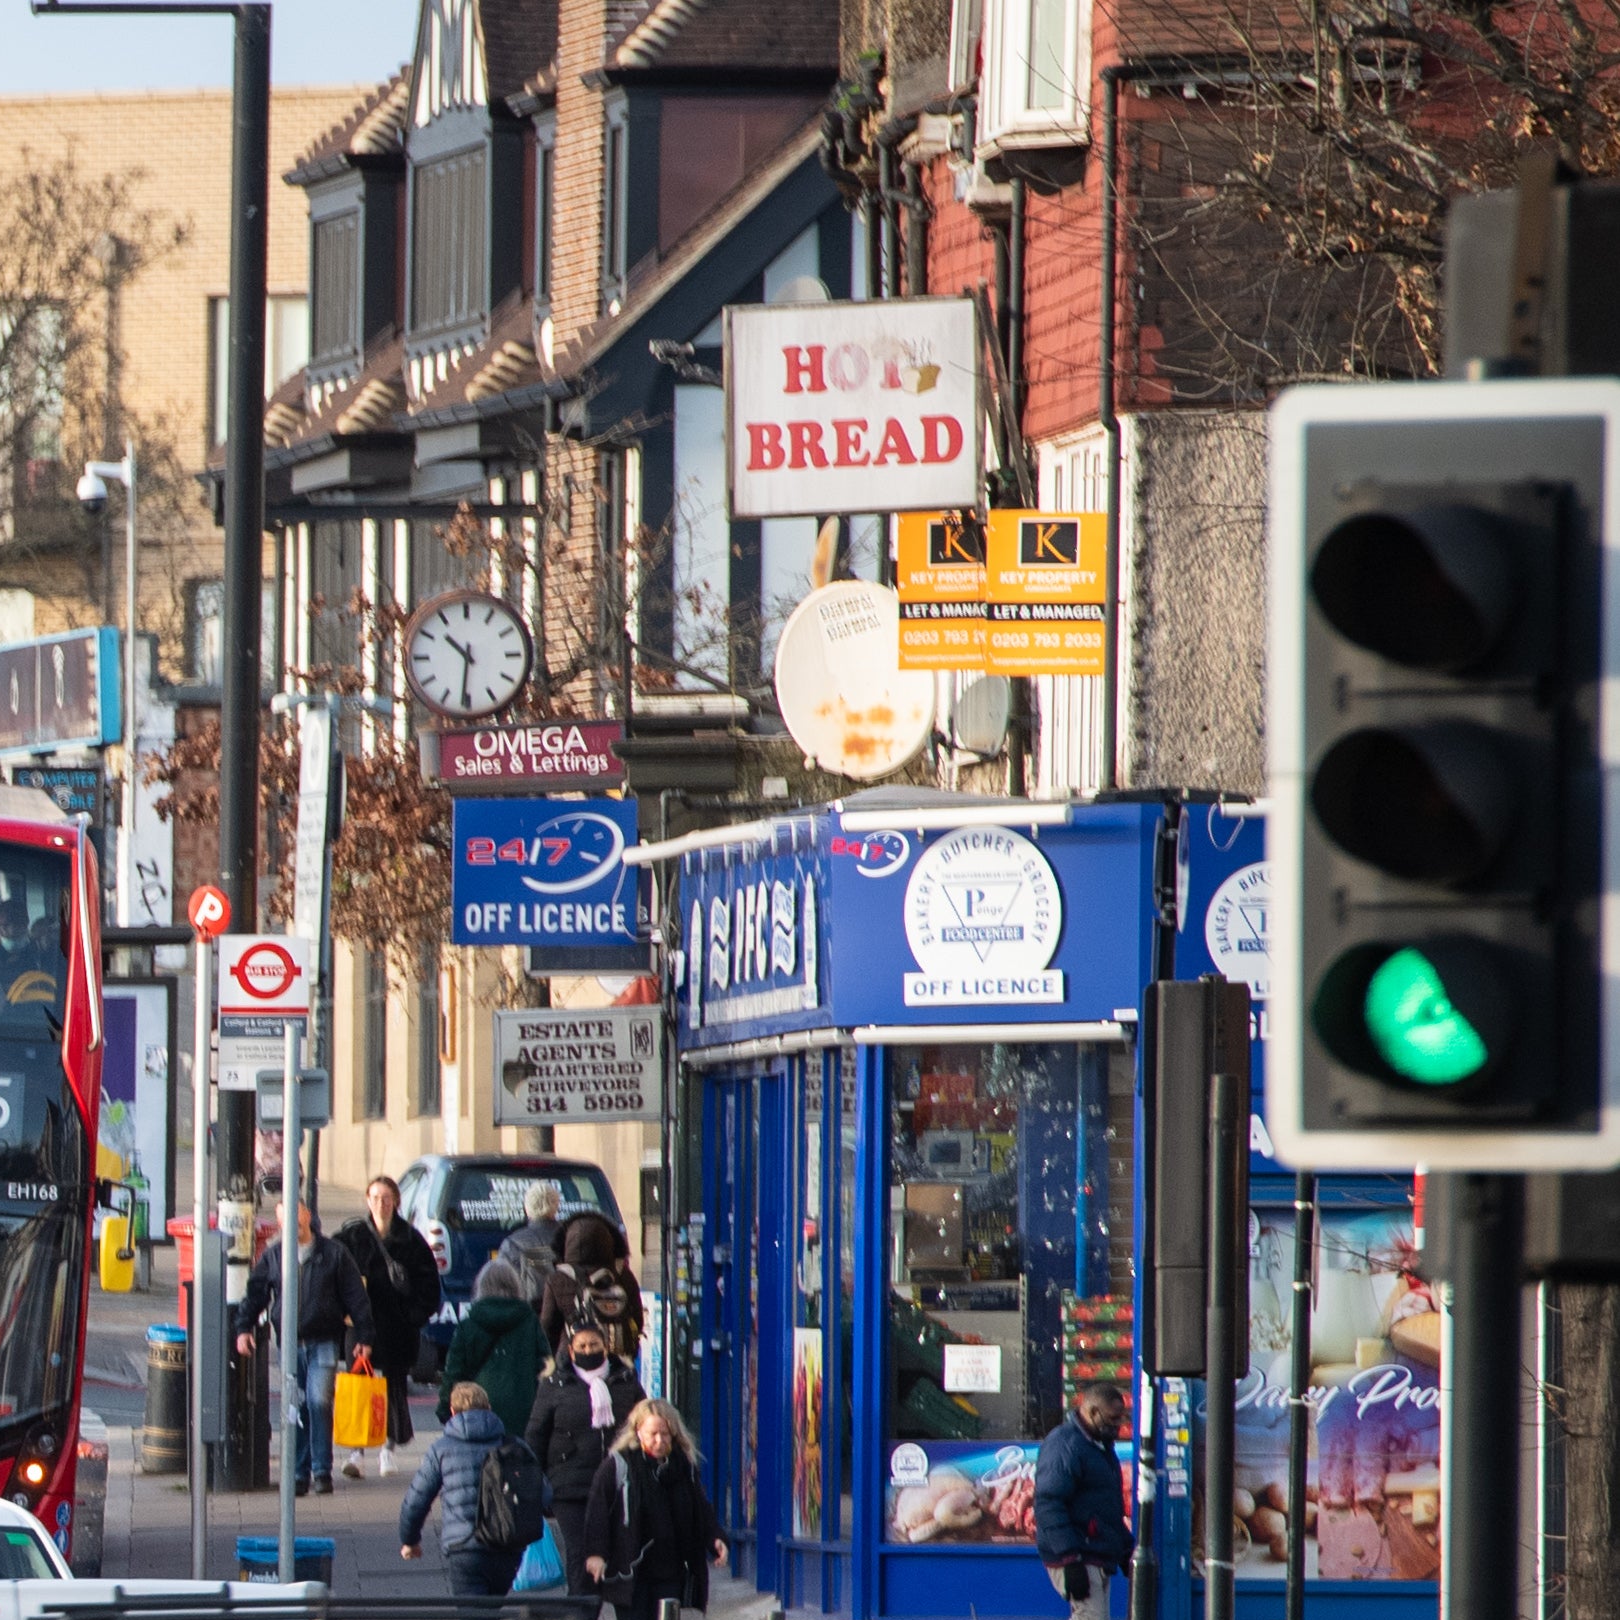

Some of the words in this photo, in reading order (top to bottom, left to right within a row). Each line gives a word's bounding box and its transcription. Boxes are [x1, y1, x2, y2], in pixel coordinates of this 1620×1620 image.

[782, 343, 903, 395] HOT
[746, 414, 964, 471] BREAD
[1035, 523, 1071, 564] K
[911, 571, 935, 583] KEY
[1000, 571, 1024, 583] KEY
[1027, 571, 1096, 585] PROPERTY
[905, 603, 928, 617] LET
[929, 604, 940, 617] &
[994, 604, 1017, 619] LET
[1018, 606, 1030, 619] &
[1032, 605, 1101, 620] MANAGED
[904, 631, 939, 645] 0203
[944, 631, 968, 643] 793
[992, 633, 1028, 648] 0203
[1034, 633, 1060, 647] 793
[473, 725, 588, 757] OMEGA
[455, 755, 502, 776] Sales
[510, 754, 524, 774] &
[532, 752, 609, 776] Lettings
[466, 837, 571, 866] 24/7
[915, 873, 936, 946] BAKERY
[940, 832, 1015, 863] BUTCHER
[1023, 859, 1050, 945] GROCERY
[194, 891, 224, 927] P
[465, 903, 512, 933] OFF
[519, 903, 626, 933] LICENCE
[945, 927, 978, 942] FOOD
[979, 927, 1022, 941] CENTRE
[1214, 895, 1235, 955] BAKERY
[913, 979, 954, 997] OFF
[961, 977, 1055, 996] LICENCE
[518, 1020, 613, 1041] ESTATE
[517, 1042, 617, 1062] AGENTS
[529, 1061, 643, 1078] HARTERED
[527, 1076, 640, 1094] SURVEYORS
[526, 1096, 568, 1114] 314
[583, 1093, 644, 1113] 5959
[7, 1181, 59, 1201] EH168
[491, 1178, 562, 1193] WAND
[1235, 1366, 1340, 1426] Daiy
[1348, 1363, 1442, 1421] Pro
